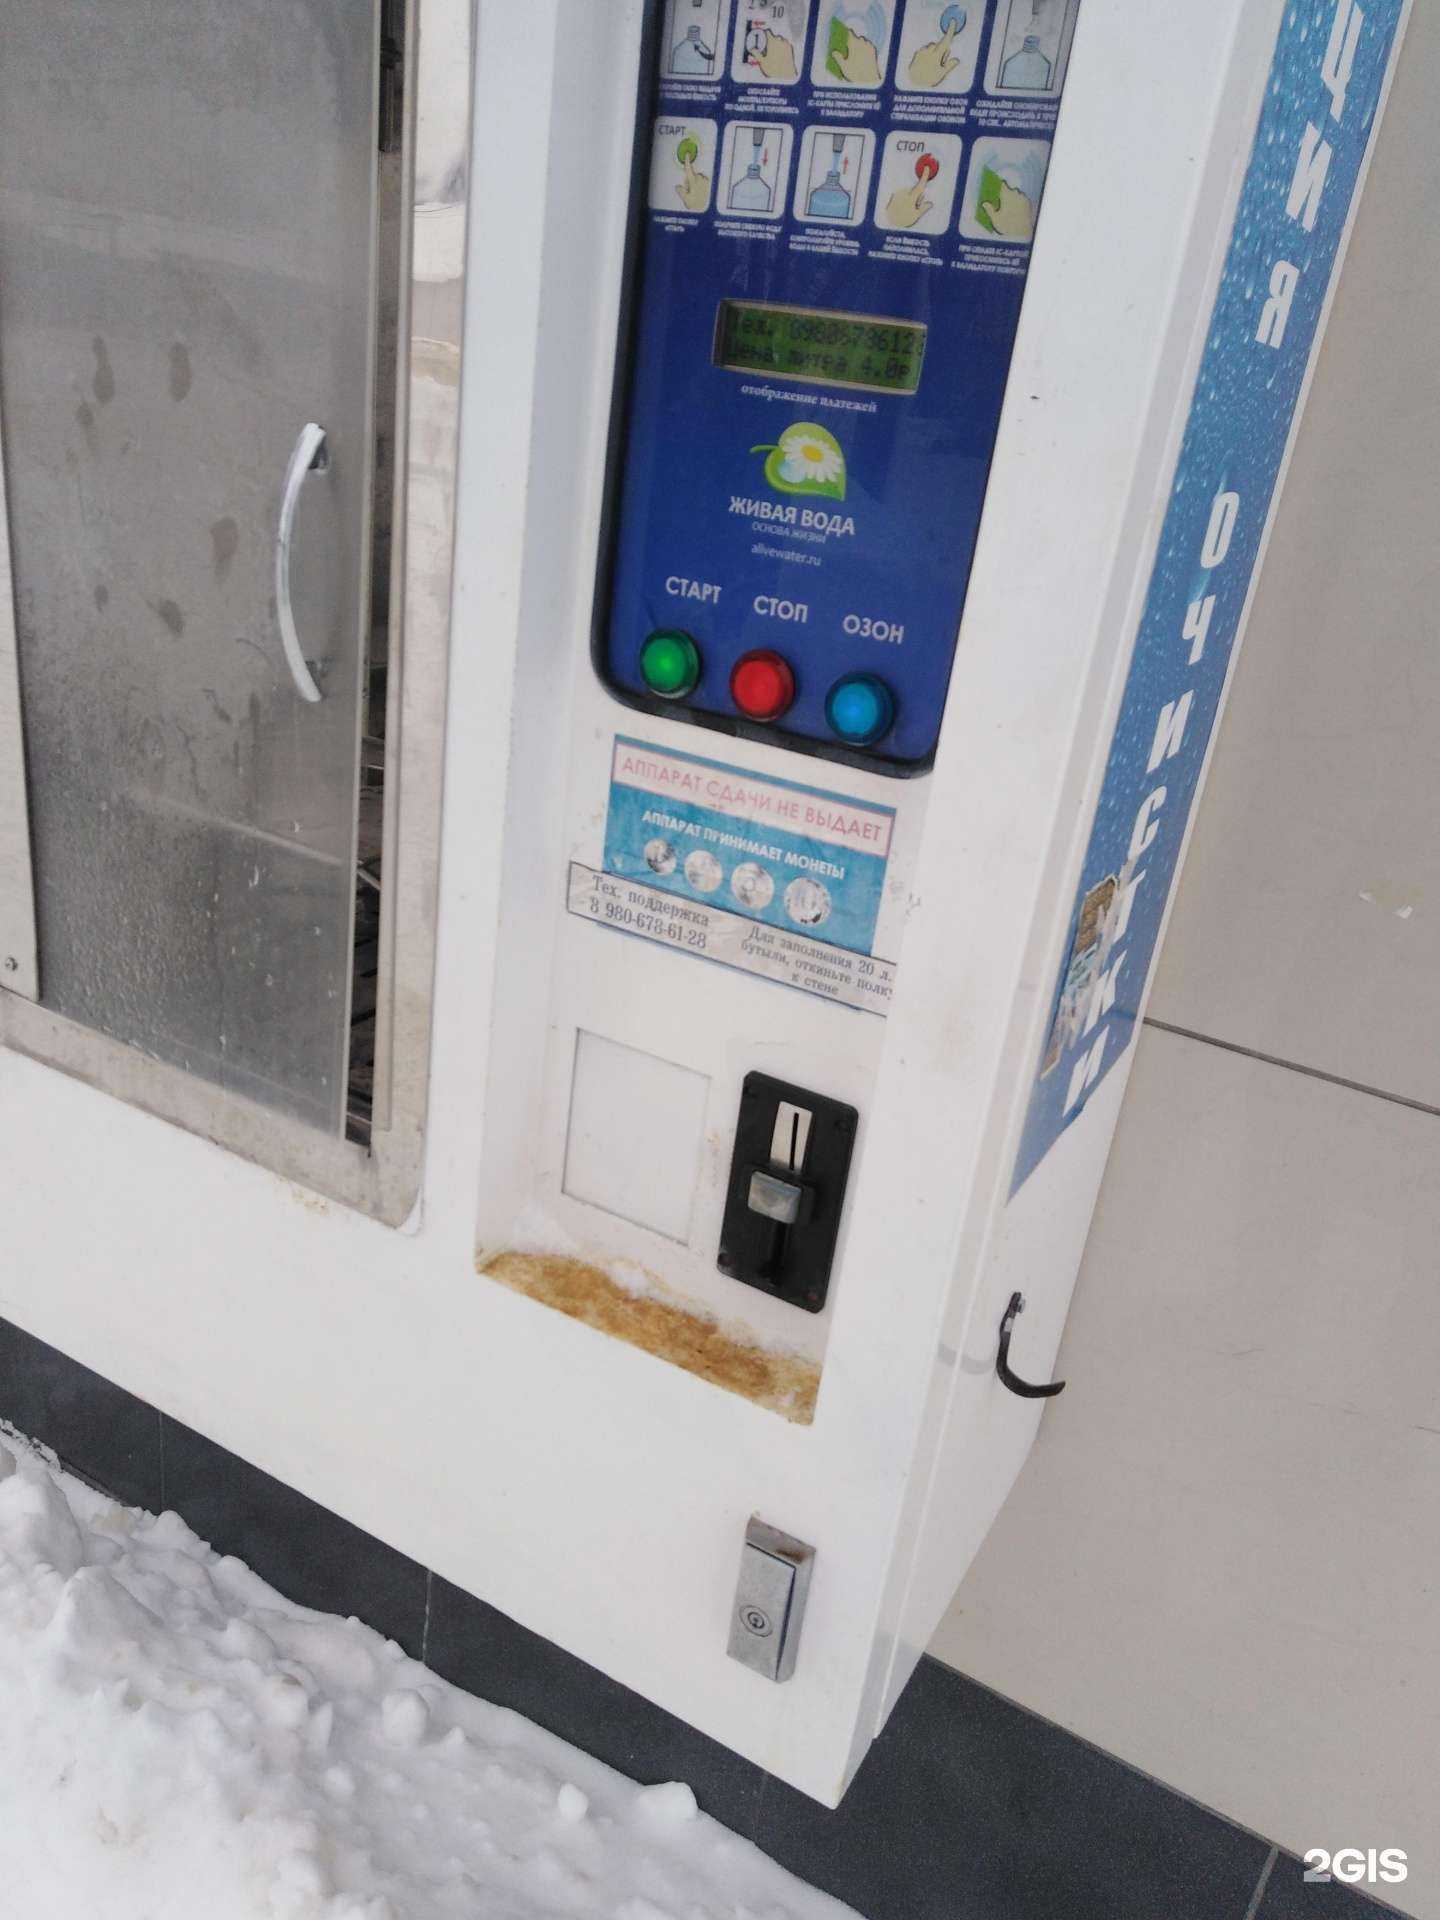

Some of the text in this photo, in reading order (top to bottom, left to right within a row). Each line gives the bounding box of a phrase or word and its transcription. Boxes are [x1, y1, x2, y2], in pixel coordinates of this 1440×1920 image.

[657, 124, 687, 137] СТАРТ
[896, 140, 926, 153] СТОП
[741, 383, 878, 414] отображение платежей
[728, 495, 856, 537] ЖИВАЯ ВОДА
[752, 521, 790, 538] ОСНОВА
[751, 541, 822, 567] alivewater.ru
[665, 575, 723, 604] СТАРТ
[753, 595, 809, 624] СТОП
[842, 614, 905, 645] ОЗОН
[621, 757, 882, 842] АППАРАТ СДАЧИ НЕ ВЫДАЕТ
[641, 810, 846, 880] АППАРАТ ПРИНИМАЕТ МОНЕТЫ
[592, 874, 710, 927] Тех. поддержка
[590, 897, 708, 949] 8 980-678-61-28
[741, 938, 791, 967] бутыли,
[795, 961, 853, 986] откиньте
[749, 925, 775, 945] Для
[781, 937, 853, 970] заполнения
[858, 959, 875, 977] 20
[791, 972, 841, 996] к стене
